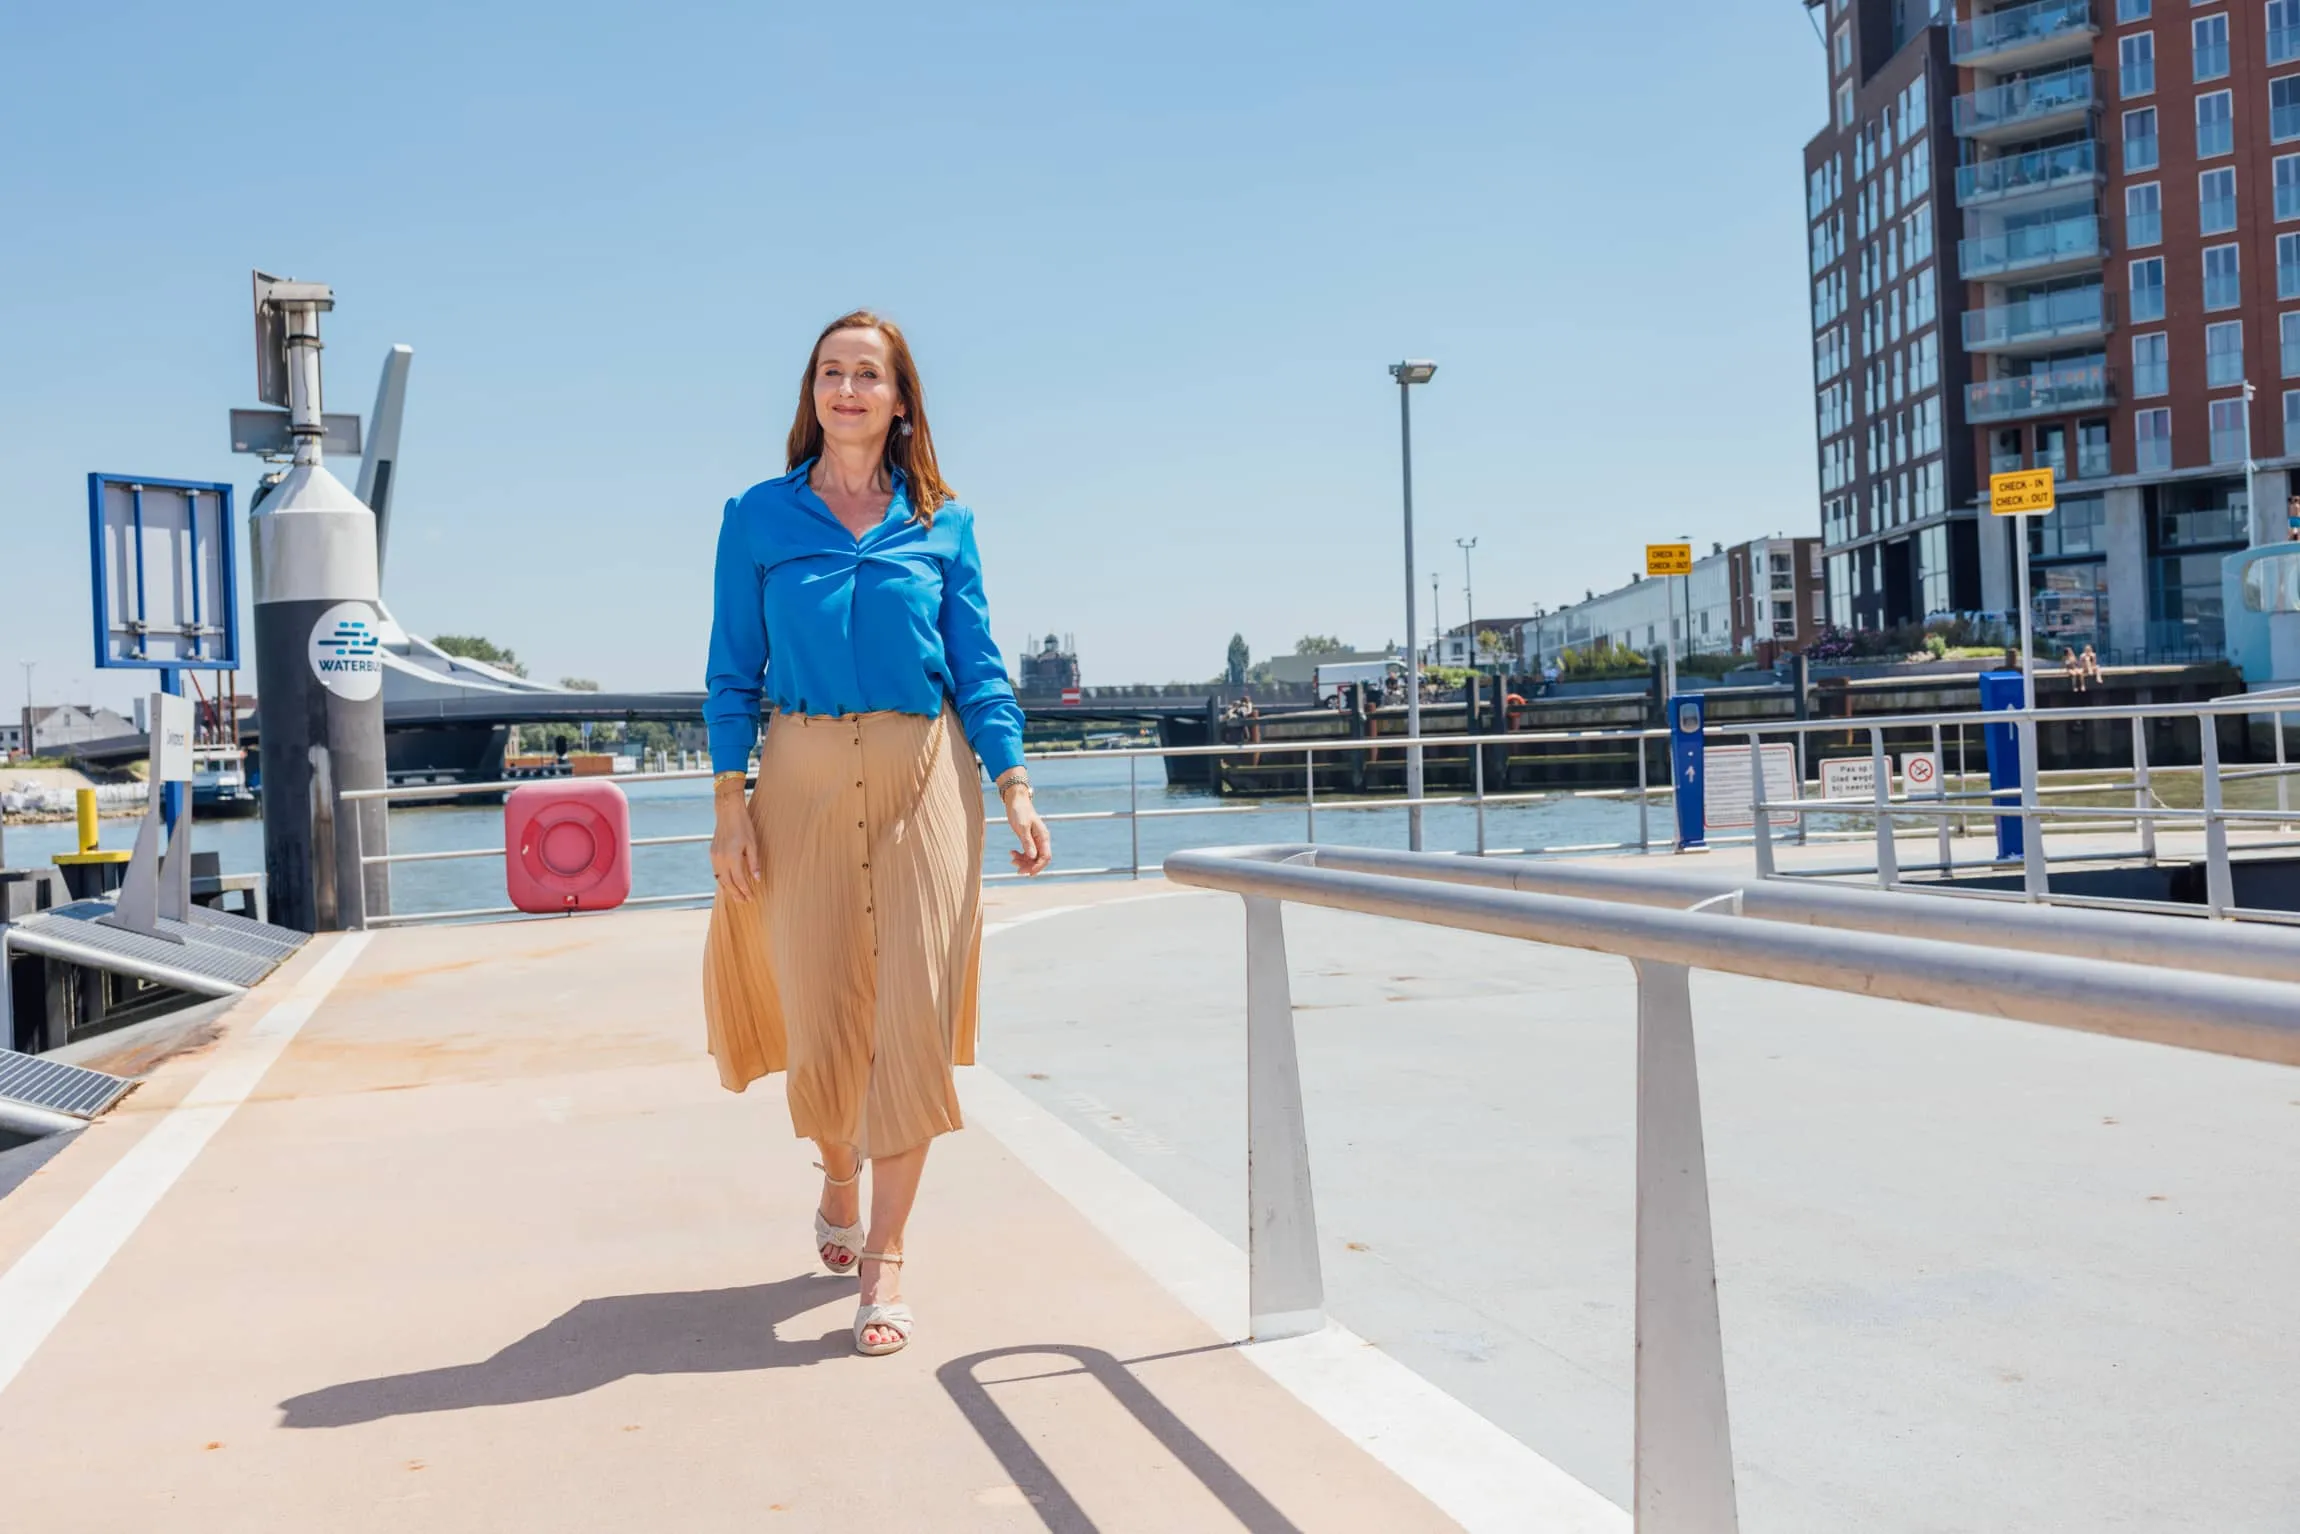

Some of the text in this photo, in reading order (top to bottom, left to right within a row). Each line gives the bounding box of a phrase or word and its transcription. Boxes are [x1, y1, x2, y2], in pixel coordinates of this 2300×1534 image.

[1999, 481, 2027, 492] CHECK
[2035, 478, 2044, 488] IN
[1995, 496, 2024, 506] CHECK
[2031, 492, 2048, 503] OUT
[1649, 561, 1670, 569] CHECK
[1676, 561, 1688, 569] OUT
